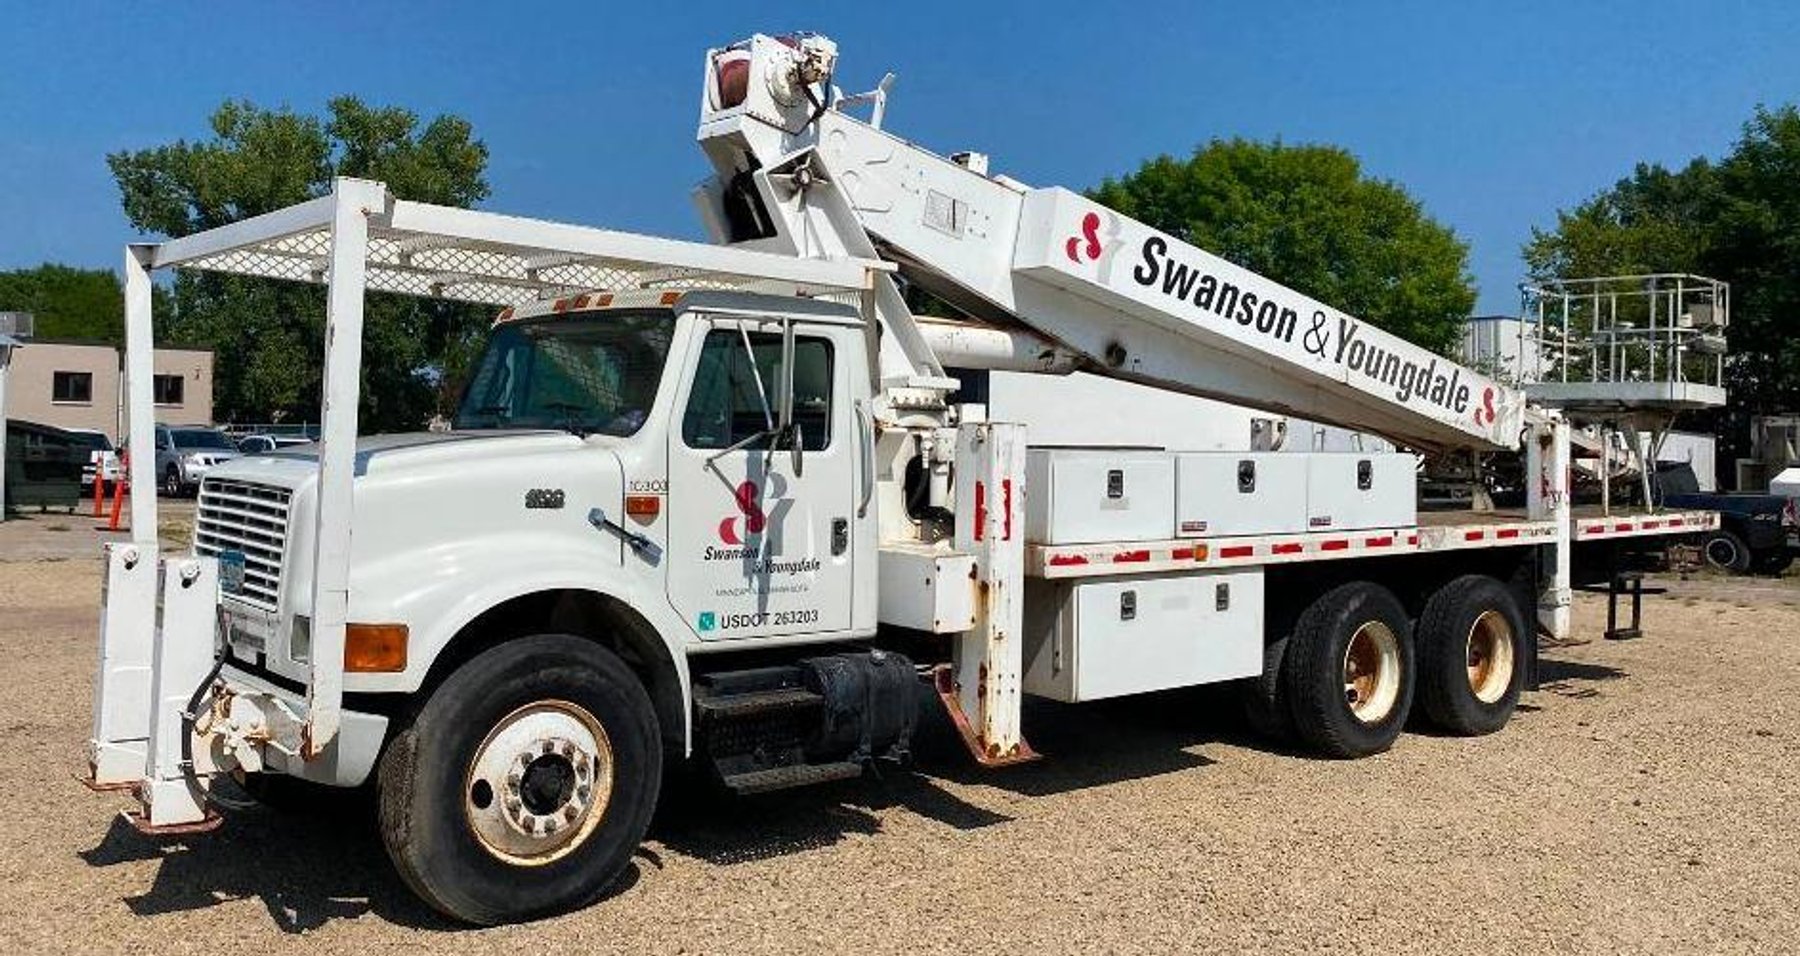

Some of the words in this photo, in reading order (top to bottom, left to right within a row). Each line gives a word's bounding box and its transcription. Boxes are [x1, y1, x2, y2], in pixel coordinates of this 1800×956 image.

[1133, 236, 1298, 343] Swanson
[1303, 311, 1330, 358] &
[1334, 317, 1470, 414] Youngdale
[704, 546, 759, 561] Swanson
[765, 558, 820, 575] Youngdale
[722, 613, 770, 629] USDOT
[774, 610, 818, 626] 263203
